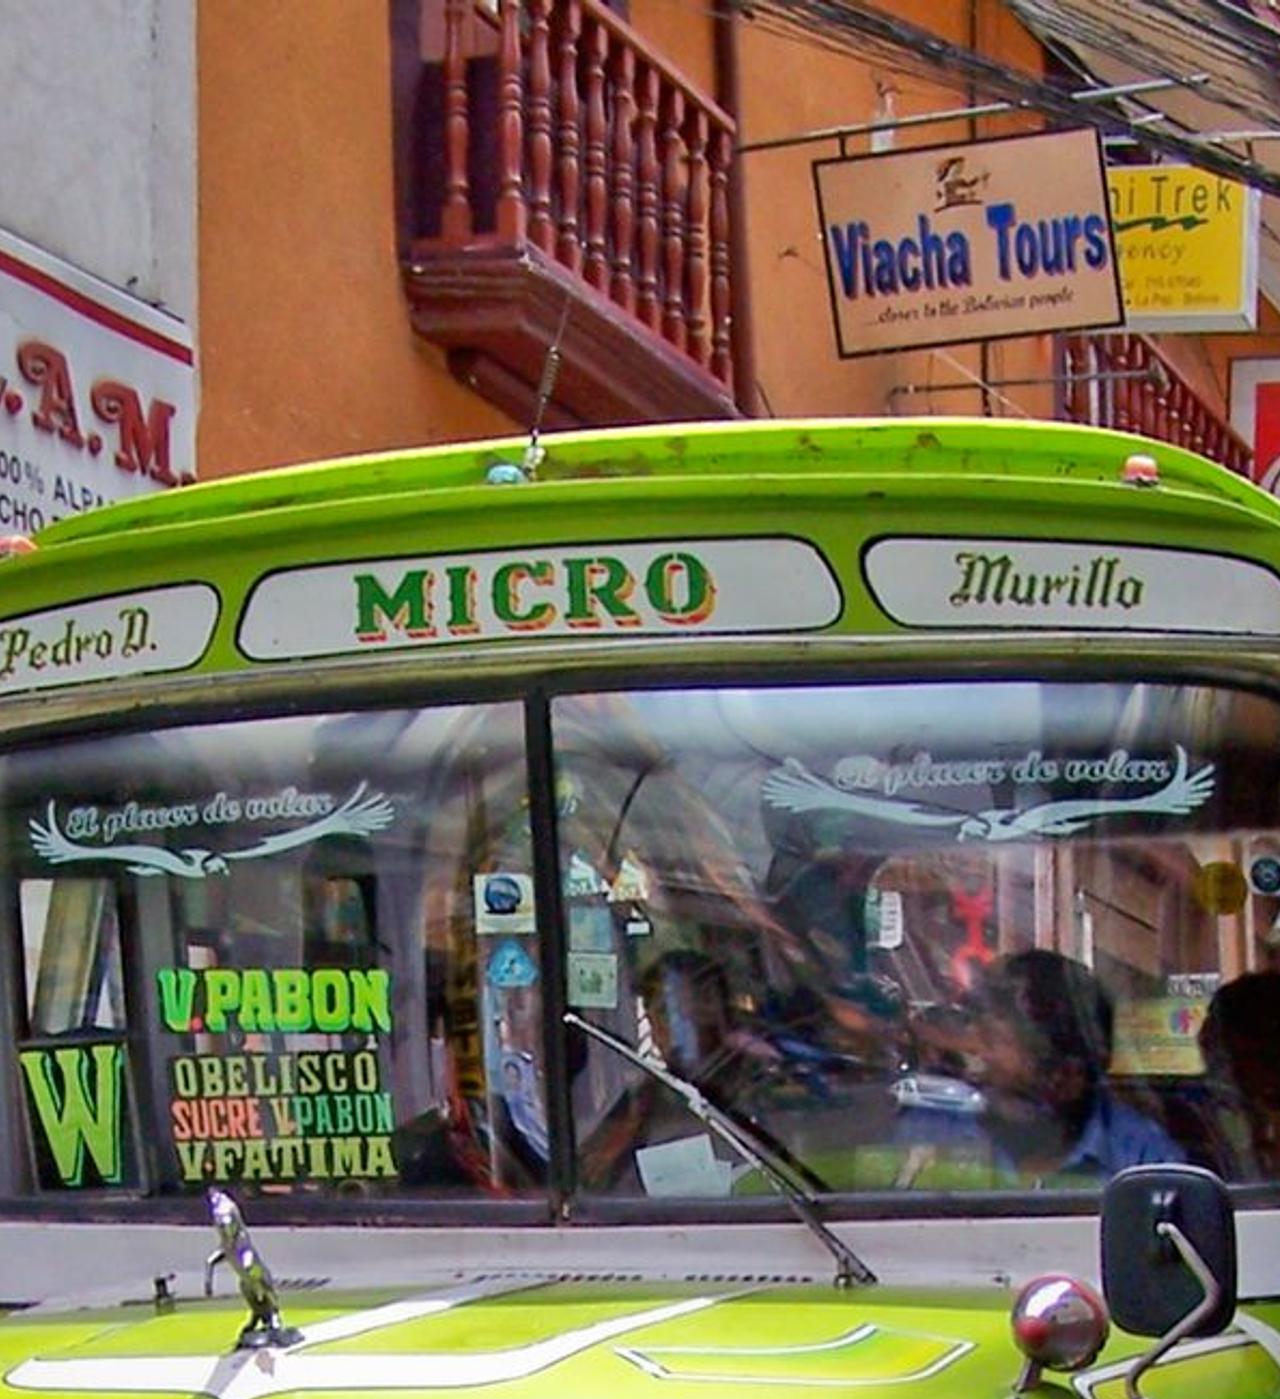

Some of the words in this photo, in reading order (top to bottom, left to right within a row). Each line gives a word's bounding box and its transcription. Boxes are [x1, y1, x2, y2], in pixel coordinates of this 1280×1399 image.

[1150, 174, 1232, 214] Trek
[830, 213, 972, 300] Viacha
[985, 202, 1107, 282] Tours
[53, 475, 116, 512] ALP
[353, 551, 718, 643] MICRO
[949, 552, 1145, 609] Murillo
[118, 606, 158, 658] D.
[883, 751, 1002, 795] placer
[1010, 750, 1058, 784] de
[1064, 749, 1171, 784] volar
[202, 792, 240, 824] de
[174, 1051, 378, 1098] OBELISCO
[21, 1045, 125, 1188] W
[171, 1097, 264, 1140] SUCRE
